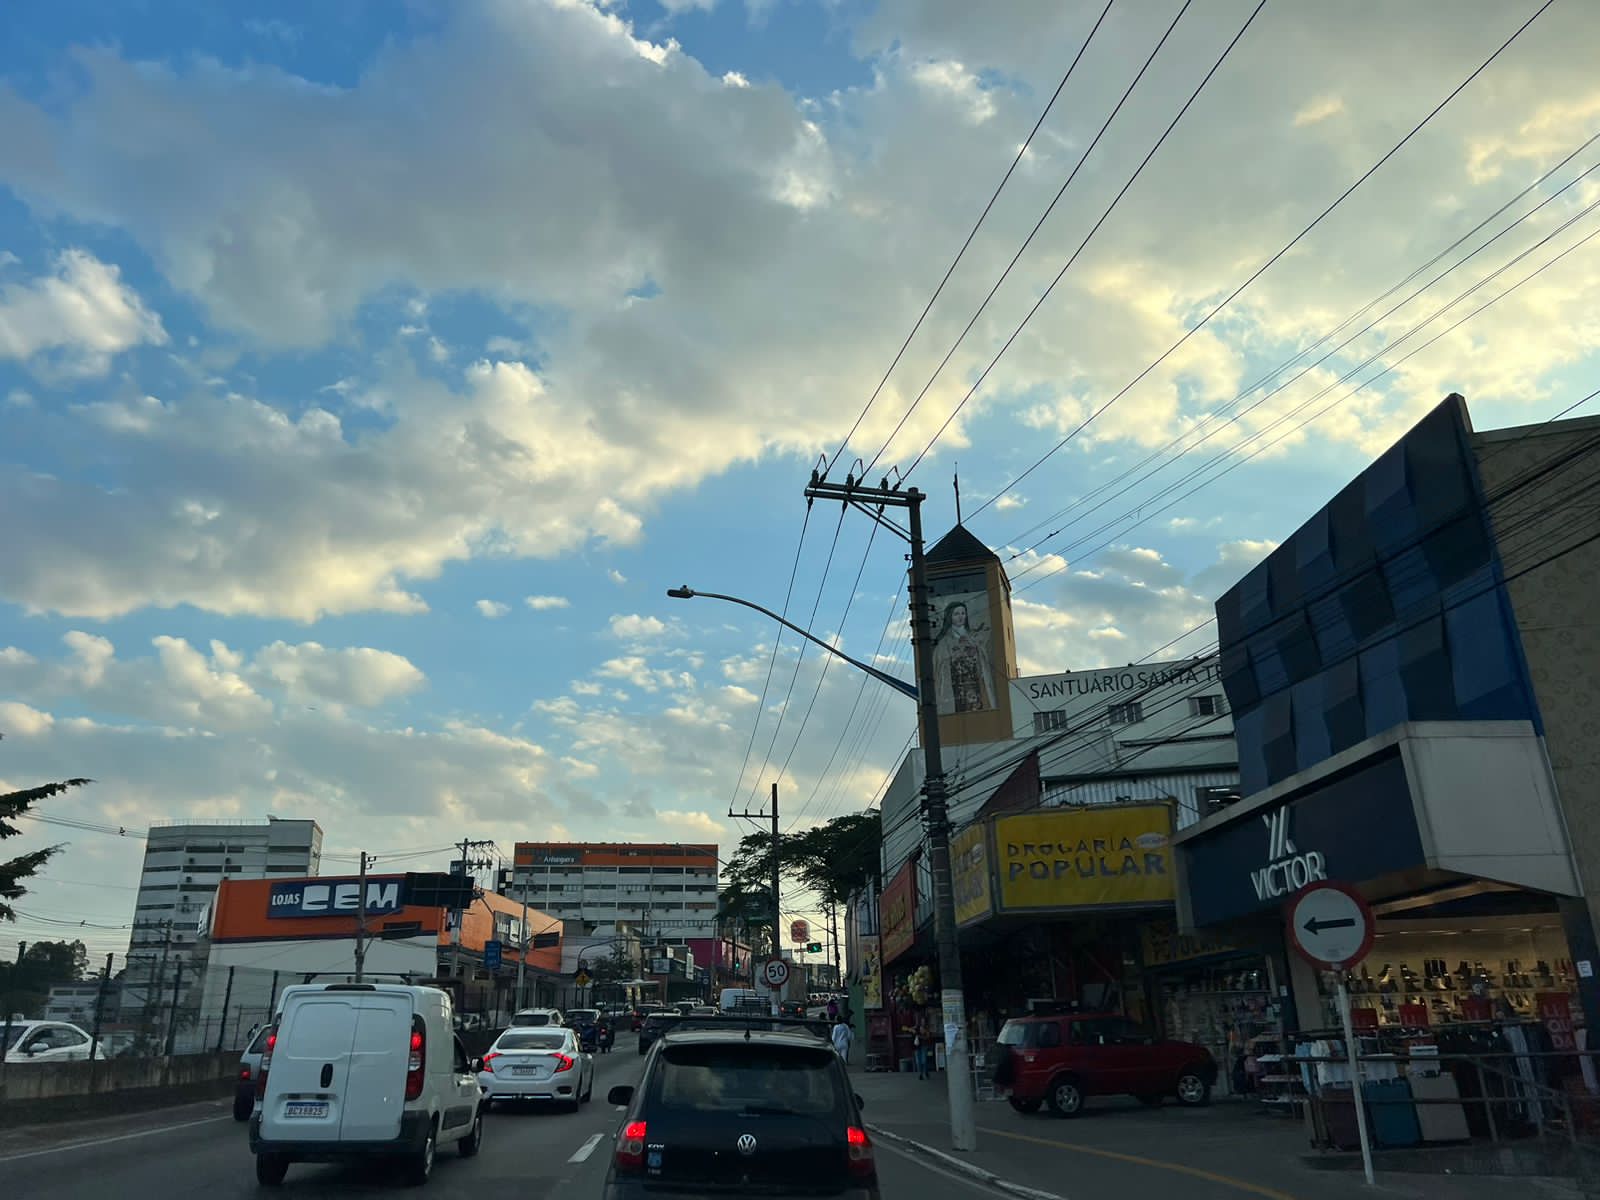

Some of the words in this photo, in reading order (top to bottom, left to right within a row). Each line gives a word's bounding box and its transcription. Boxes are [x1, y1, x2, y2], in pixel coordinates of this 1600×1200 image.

[1029, 672, 1135, 699] SANTUÁRIO
[1137, 665, 1200, 689] SANTA
[1007, 836, 1135, 857] DROGARIA
[1008, 852, 1167, 882] POPULAR
[1250, 850, 1328, 901] VICTOR
[271, 893, 301, 906] LOJAS
[302, 883, 399, 911] CEM
[768, 965, 786, 978] 50
